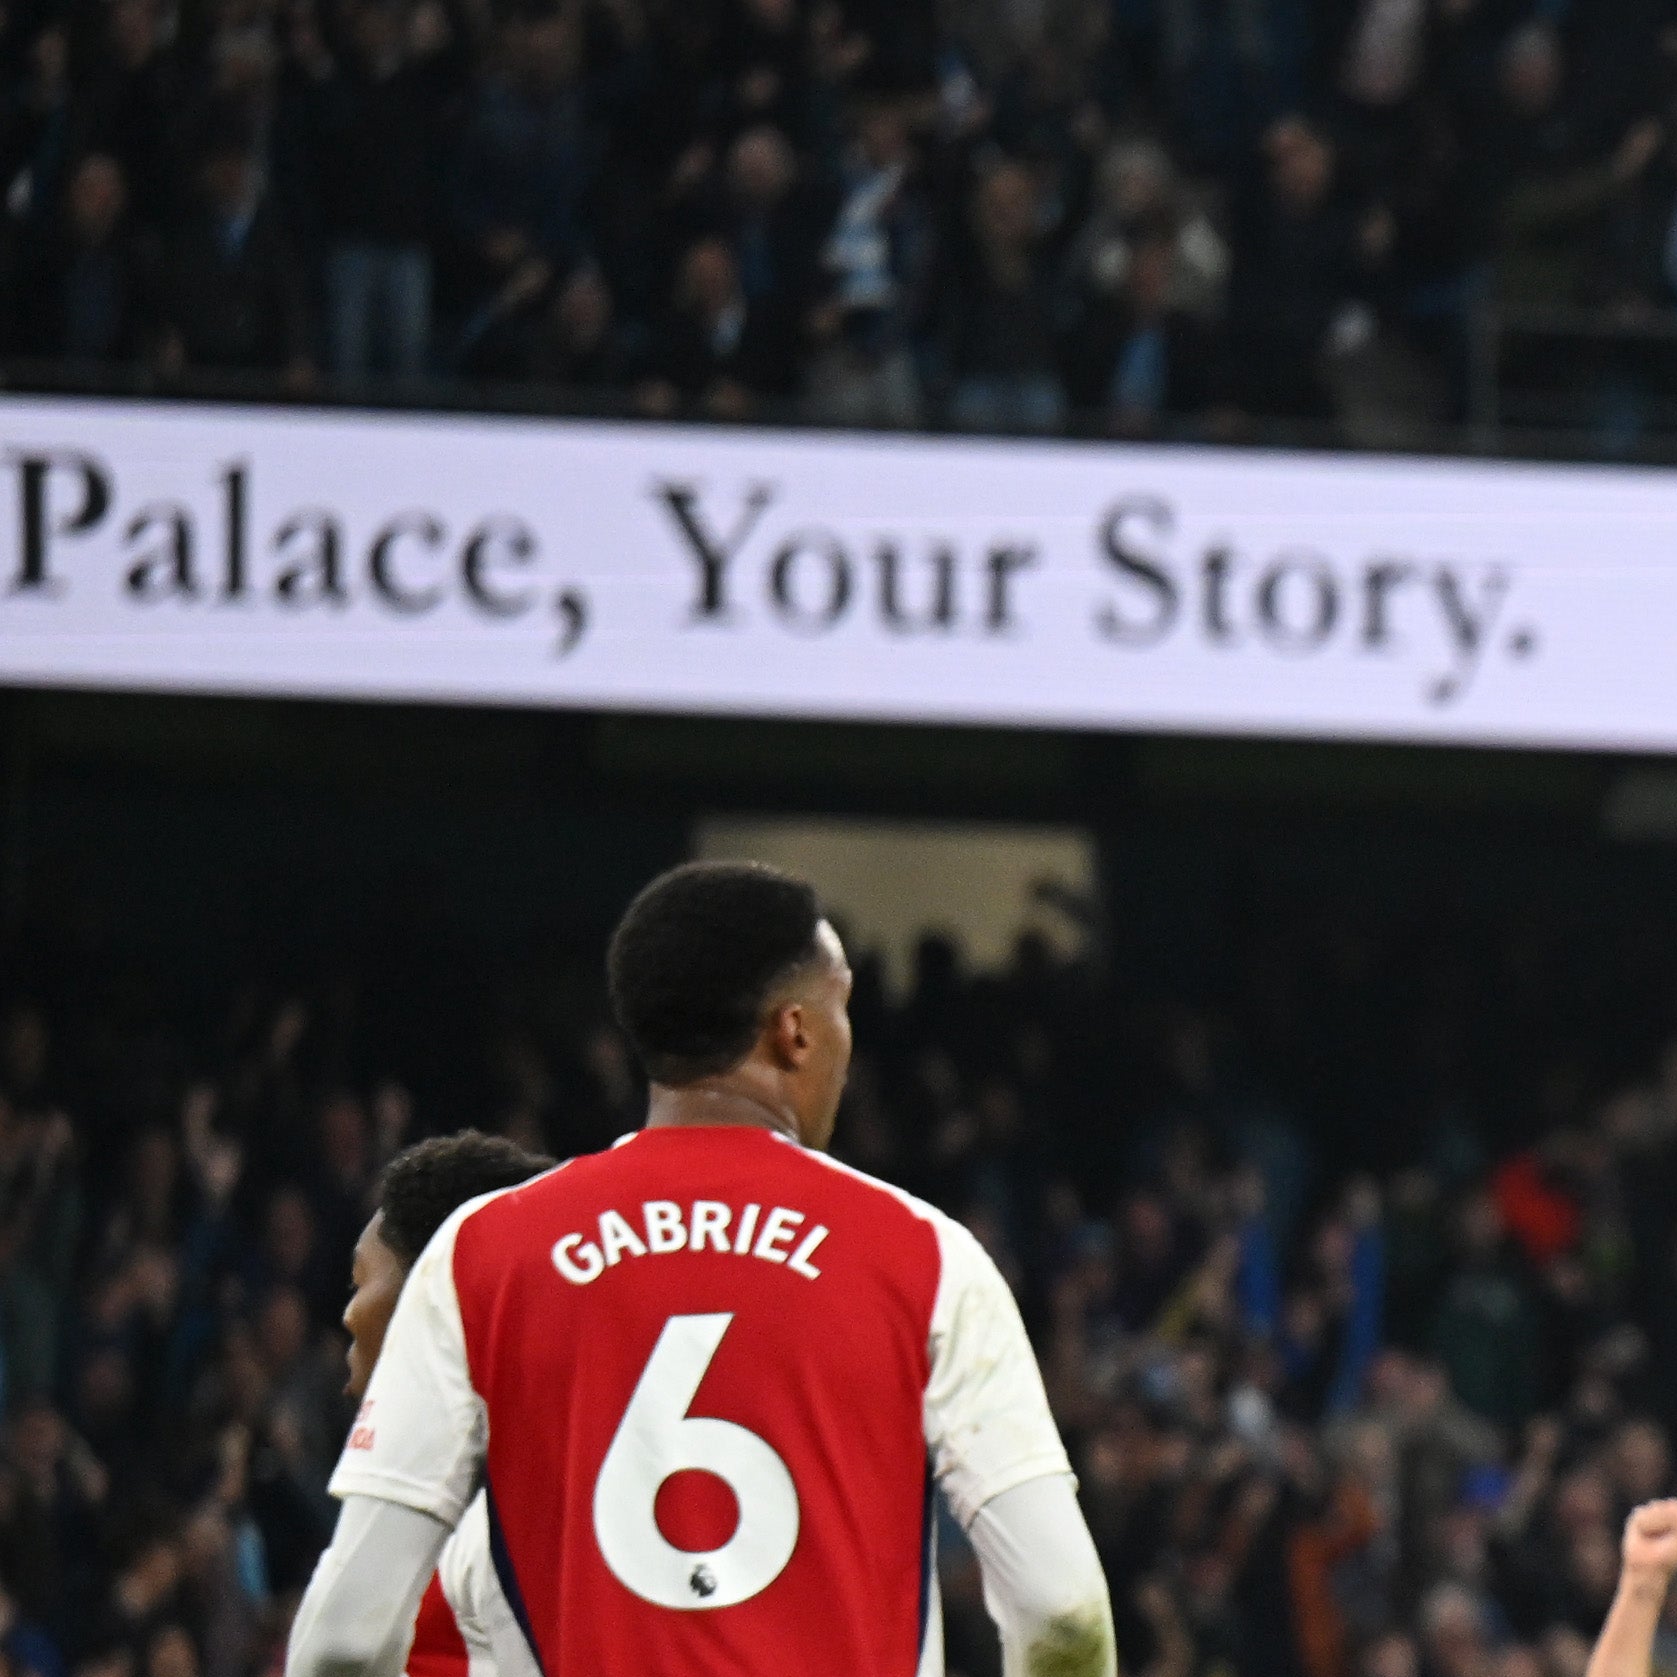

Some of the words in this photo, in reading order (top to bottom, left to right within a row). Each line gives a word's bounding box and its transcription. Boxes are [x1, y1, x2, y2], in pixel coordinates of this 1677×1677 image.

[3, 444, 590, 660] Palace,
[648, 468, 1040, 640] Your
[1092, 490, 1542, 705] Story.
[551, 1201, 832, 1286] GABRIEL
[592, 1312, 800, 1611] 6
